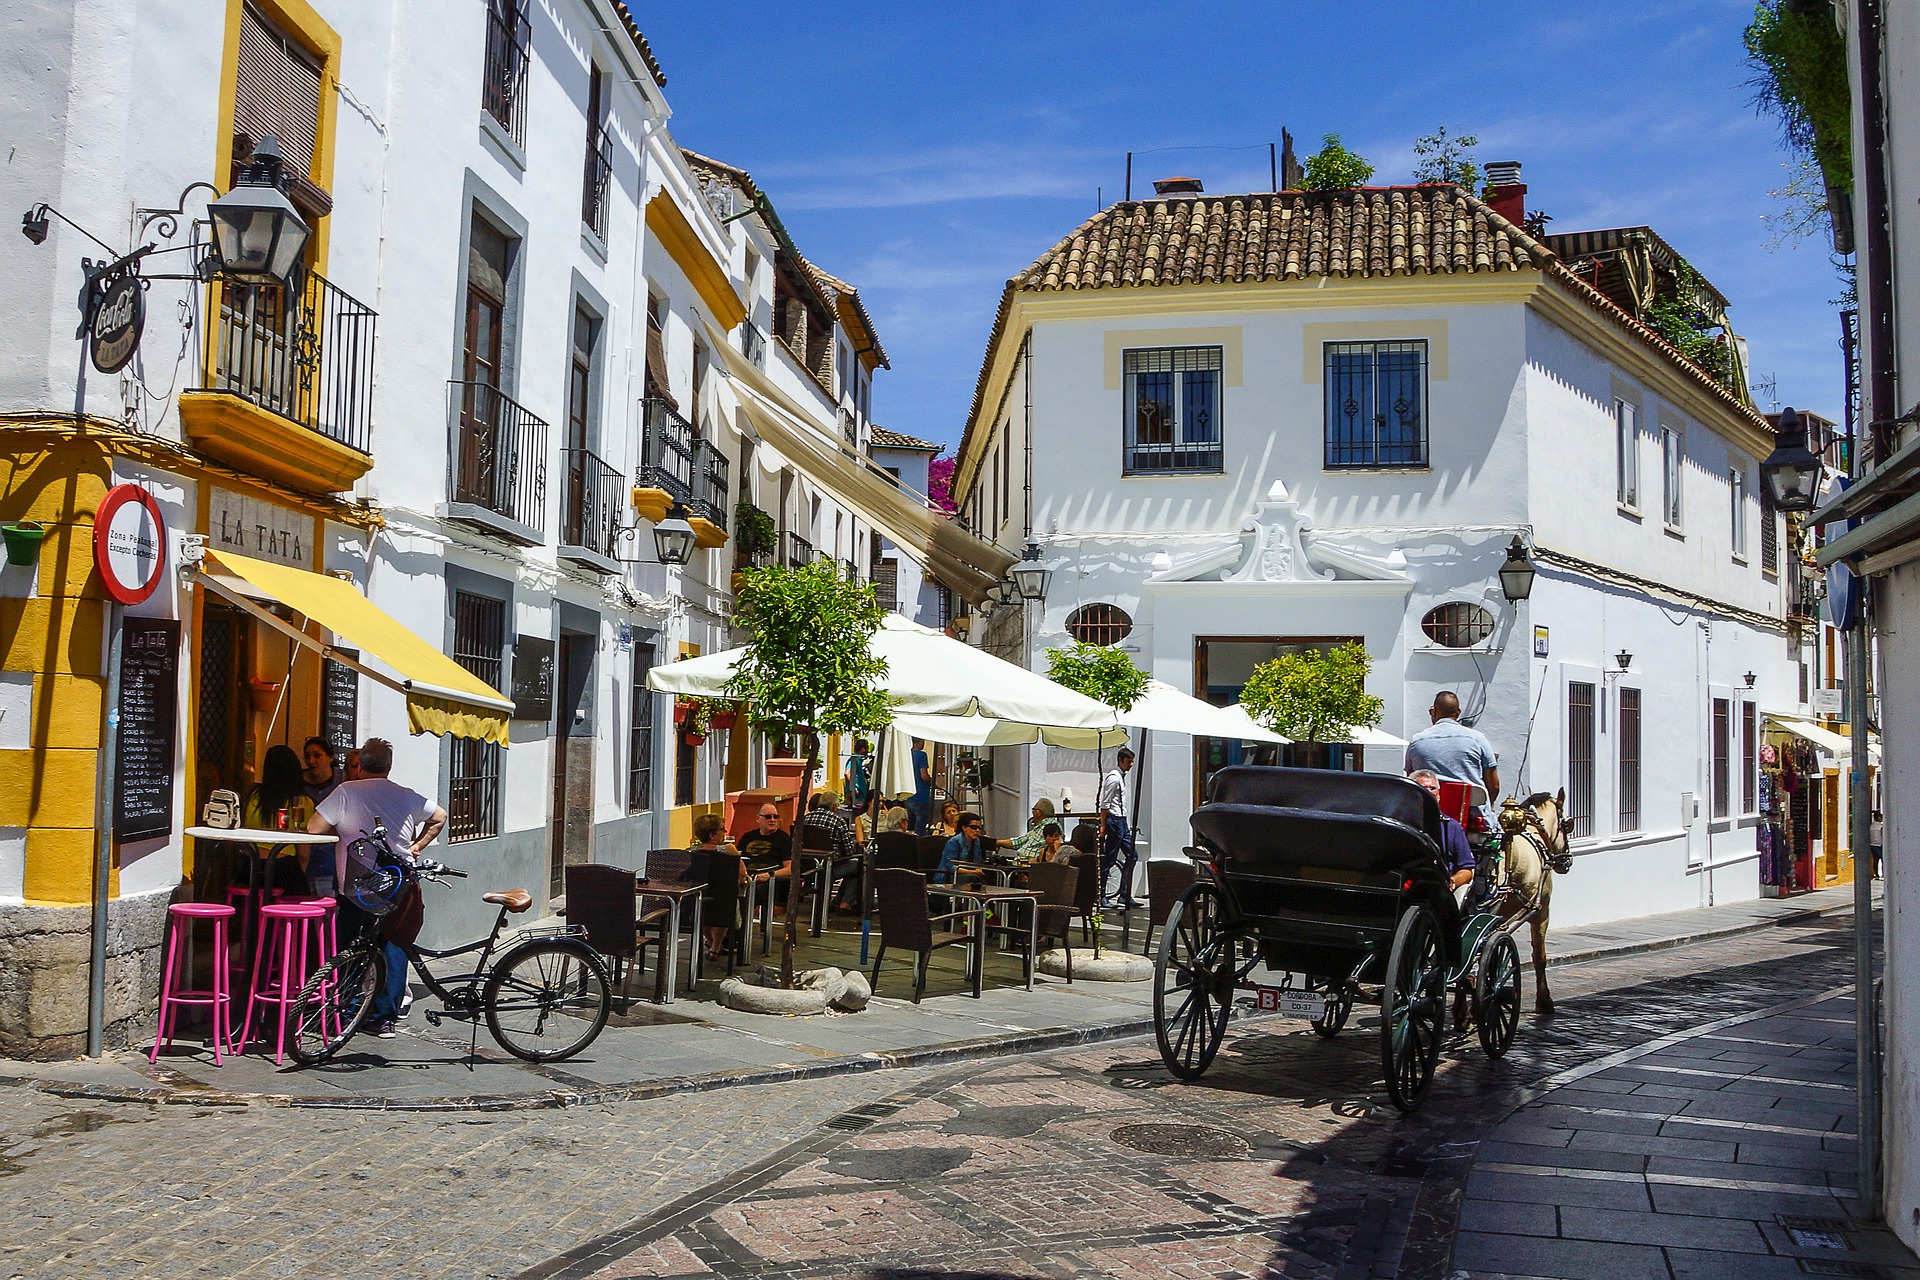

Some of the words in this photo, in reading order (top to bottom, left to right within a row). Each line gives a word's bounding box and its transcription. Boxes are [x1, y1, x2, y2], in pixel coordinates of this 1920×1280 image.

[110, 530, 126, 541] Zona
[129, 534, 157, 548] Peatonal
[222, 510, 244, 546] LA
[256, 524, 302, 561] TATA
[109, 542, 131, 555] Excepto
[132, 547, 157, 560] Cocheras
[1263, 993, 1274, 1008] B
[1287, 992, 1317, 1000] CORDOBA
